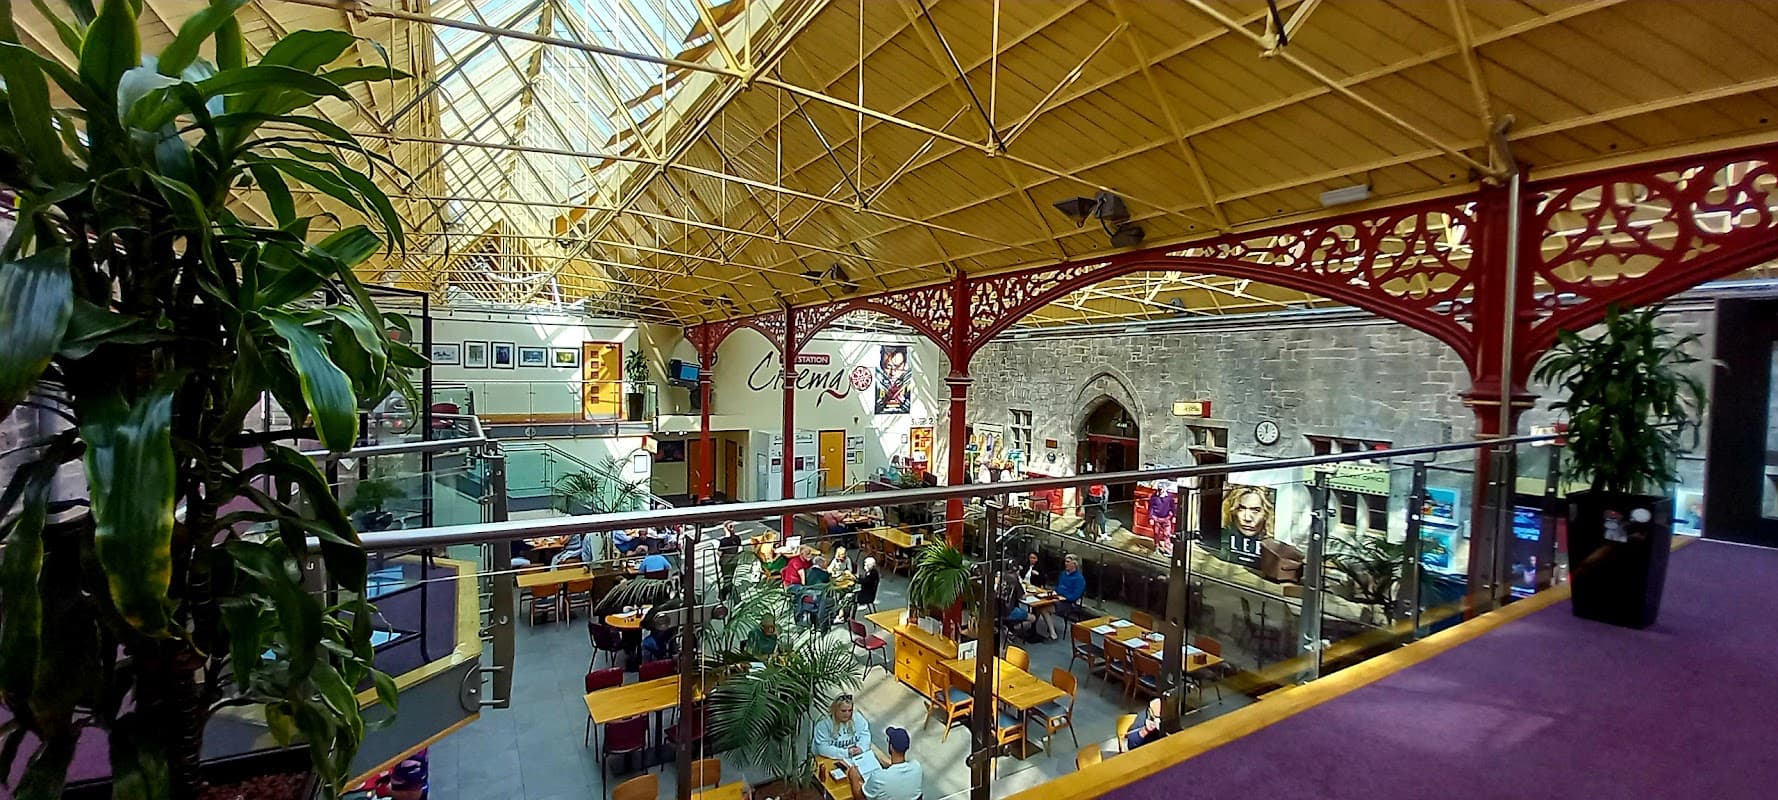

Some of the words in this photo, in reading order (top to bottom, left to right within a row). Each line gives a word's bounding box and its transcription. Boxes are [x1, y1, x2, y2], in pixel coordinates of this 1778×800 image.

[798, 356, 829, 364] STATION
[747, 350, 850, 404] Ciema
[1230, 535, 1262, 555] LEE
